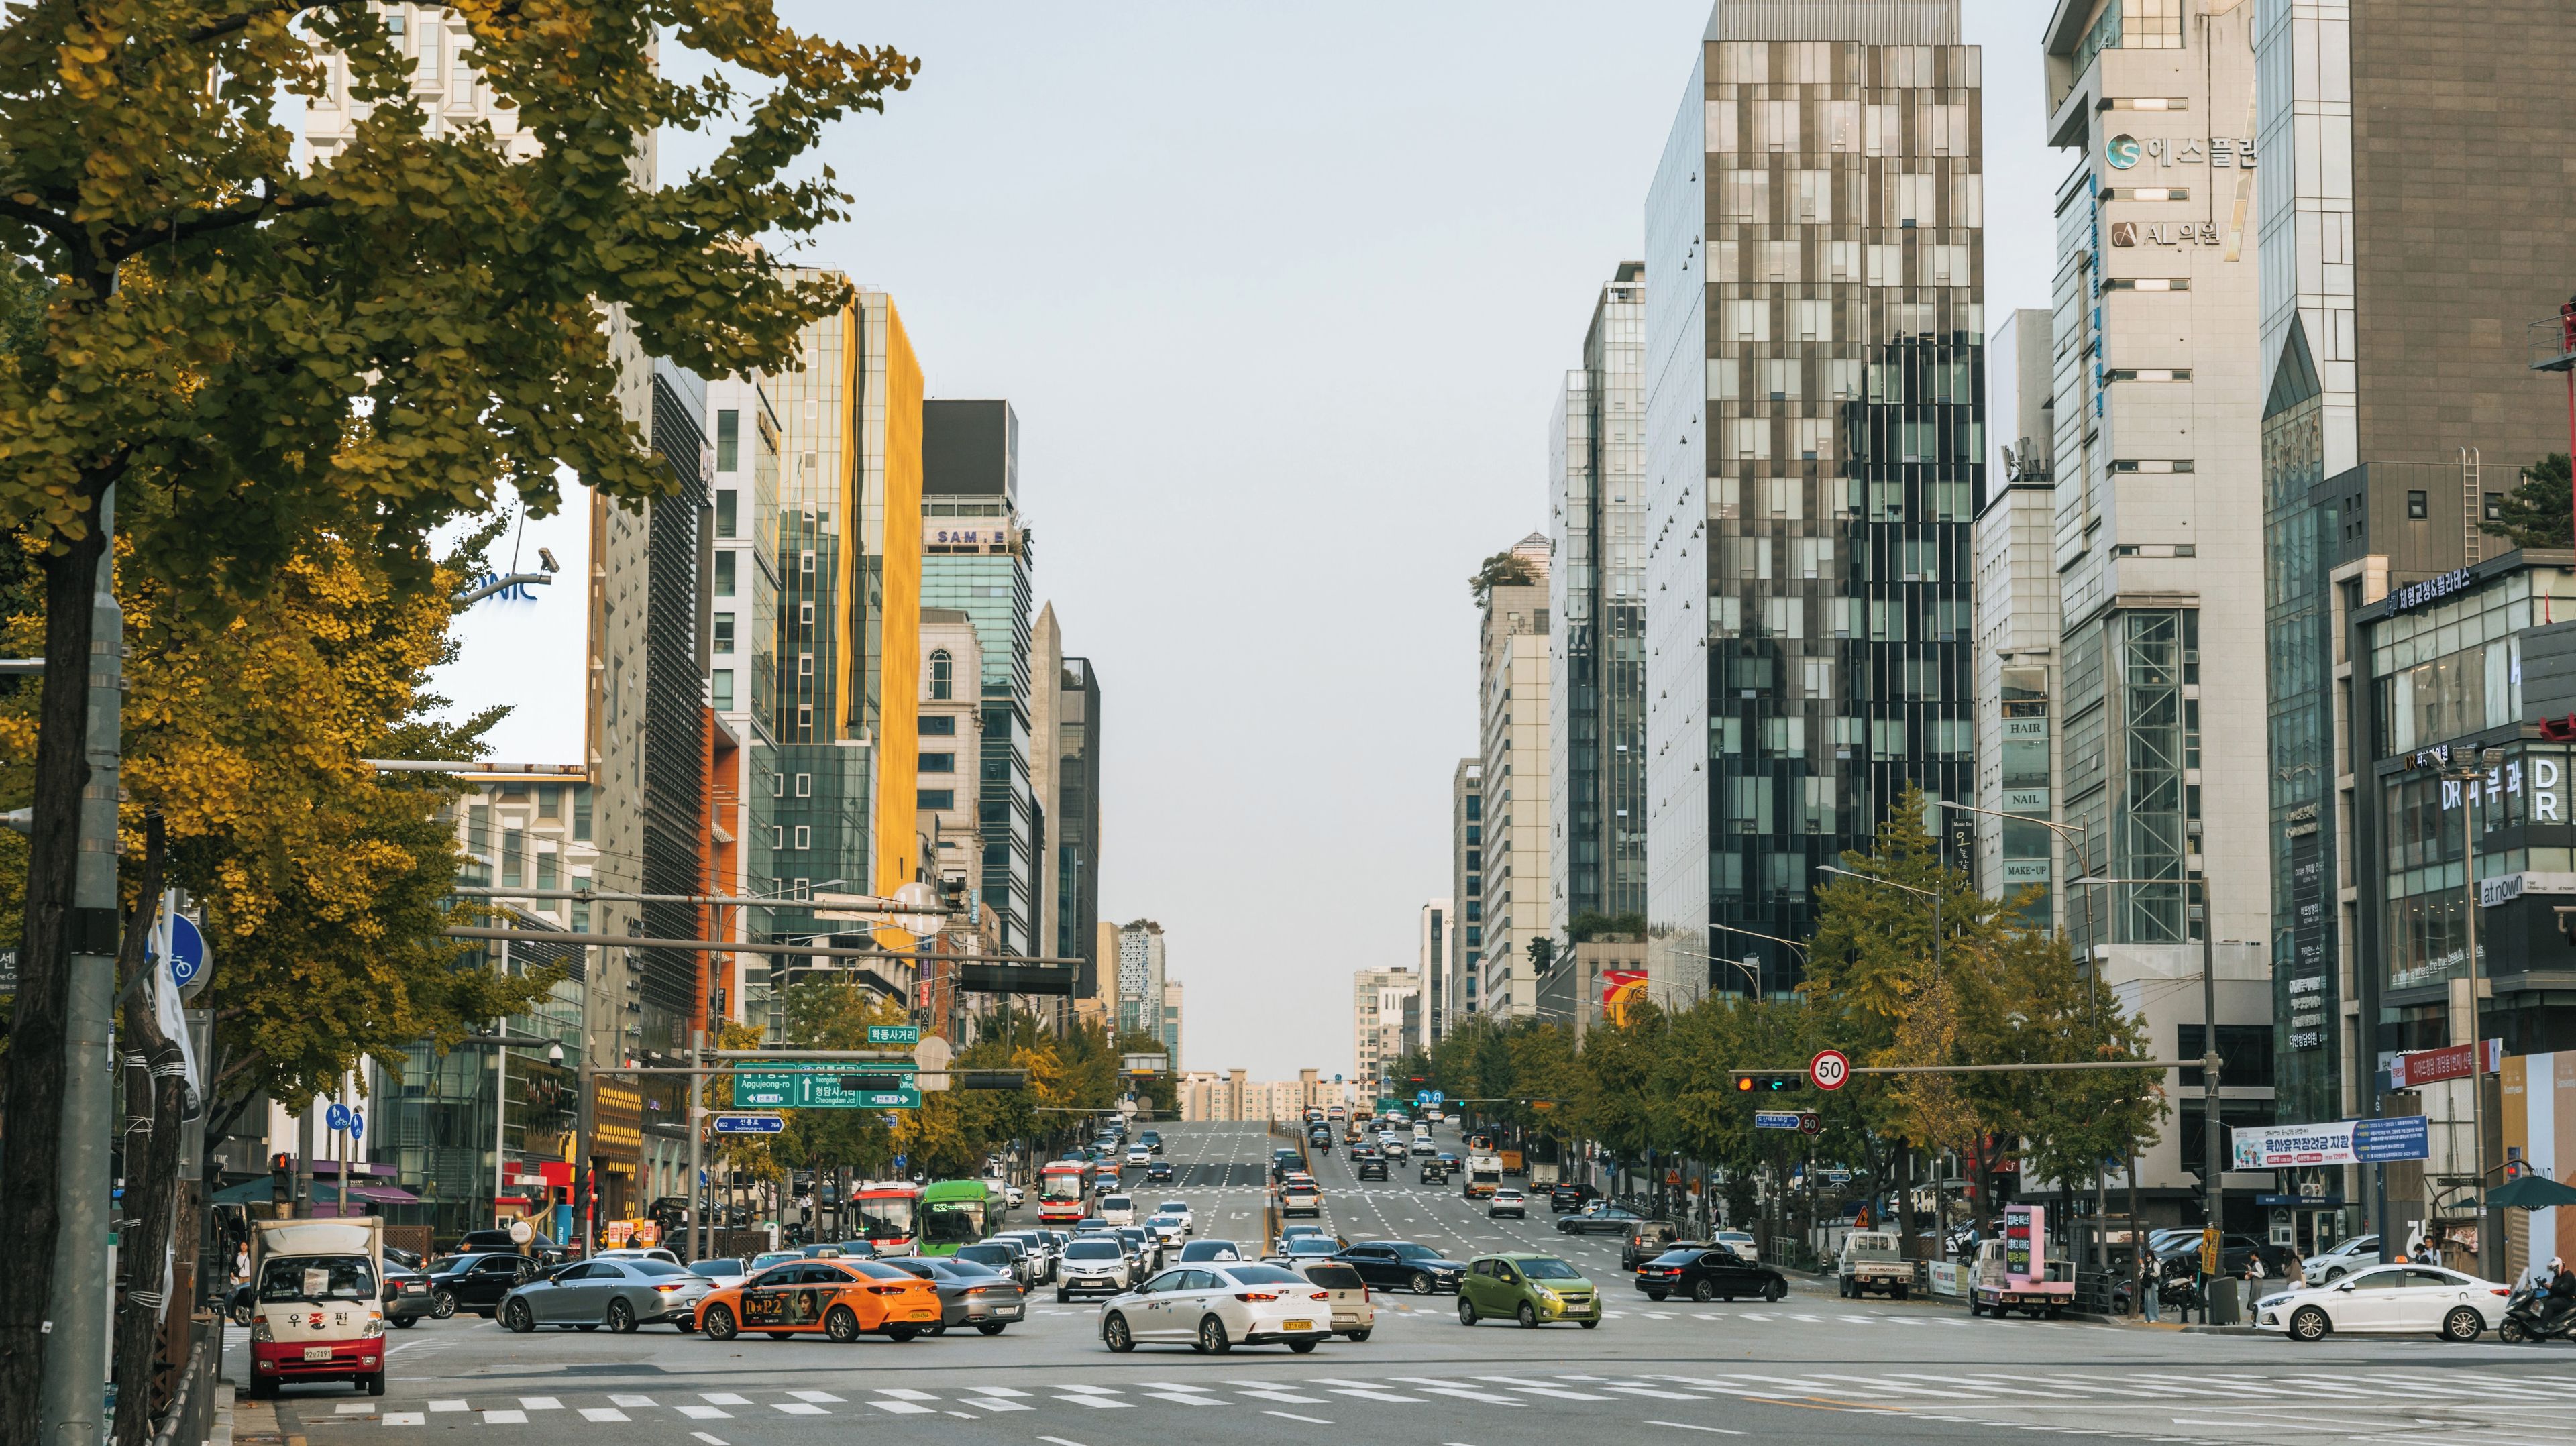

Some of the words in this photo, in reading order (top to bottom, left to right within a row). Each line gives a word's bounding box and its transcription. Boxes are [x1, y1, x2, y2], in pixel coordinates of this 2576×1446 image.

[938, 531, 1004, 543] SAME
[2400, 567, 2471, 609] 체형교정&필라테스
[2010, 724, 2041, 734] HAIR
[2405, 753, 2418, 771] DR
[2012, 795, 2040, 804] NAIL
[2443, 780, 2461, 810] DR
[2008, 866, 2047, 875] MAKE-UP
[2484, 881, 2494, 903] at
[2496, 875, 2522, 901] nown
[2392, 973, 2397, 983] at
[2410, 972, 2415, 980] is
[2415, 966, 2429, 977] where
[2438, 957, 2447, 967] true
[2448, 947, 2463, 962] beauty
[872, 1029, 916, 1040] 학동사거리
[1819, 1061, 1841, 1078] 50
[2414, 1058, 2435, 1078] 디아드청담
[741, 1080, 790, 1089] Apgujeong-ro
[815, 1097, 846, 1105] Cheongdam
[1804, 1119, 1815, 1129] 50
[2265, 1136, 2328, 1152] 육아휴직장려금
[2330, 1135, 2349, 1149] 지원
[288, 1314, 301, 1327] 우
[335, 1312, 347, 1326] 편
